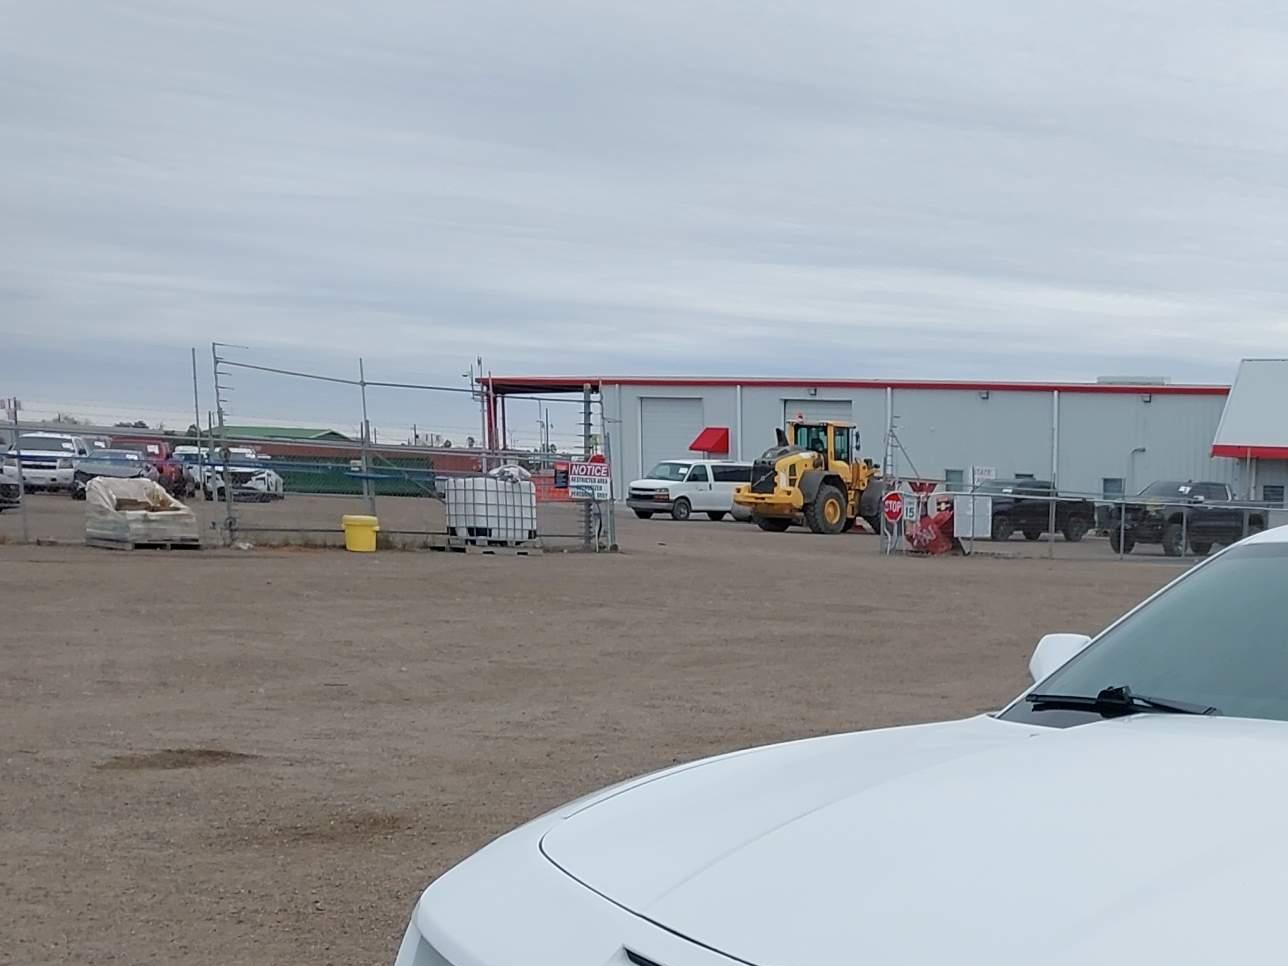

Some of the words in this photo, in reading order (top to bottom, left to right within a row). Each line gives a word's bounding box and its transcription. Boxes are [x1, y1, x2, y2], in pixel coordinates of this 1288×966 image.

[571, 464, 608, 477] NOTICE
[884, 500, 902, 512] STOP
[905, 506, 915, 518] 15
